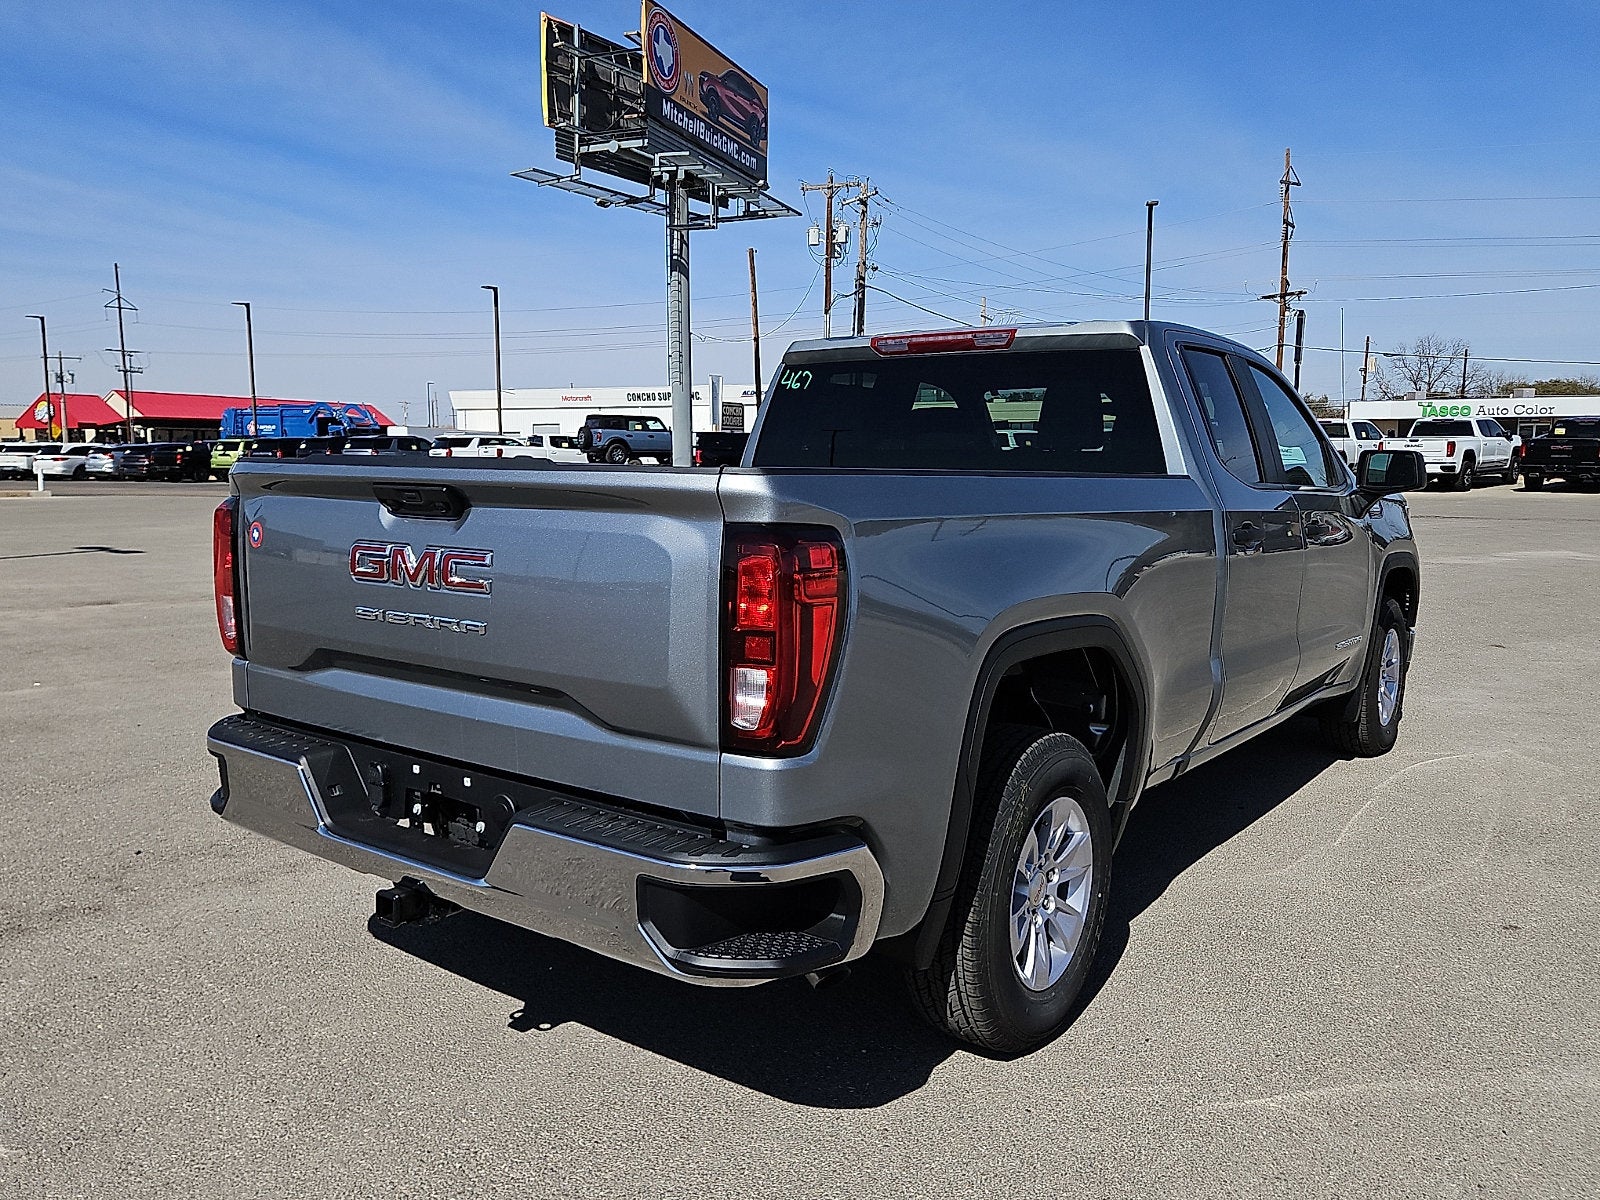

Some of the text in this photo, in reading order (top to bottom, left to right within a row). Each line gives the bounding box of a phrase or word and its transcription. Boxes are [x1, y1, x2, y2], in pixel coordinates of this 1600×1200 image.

[662, 99, 757, 170] MitchellBuickGMC.com
[781, 369, 812, 389] 467
[626, 392, 656, 402] CONCHO
[722, 406, 743, 416] CONCHO
[1418, 402, 1556, 417] TASCO Auto Color
[349, 539, 494, 598] GMC
[354, 605, 488, 636] SIERRA
